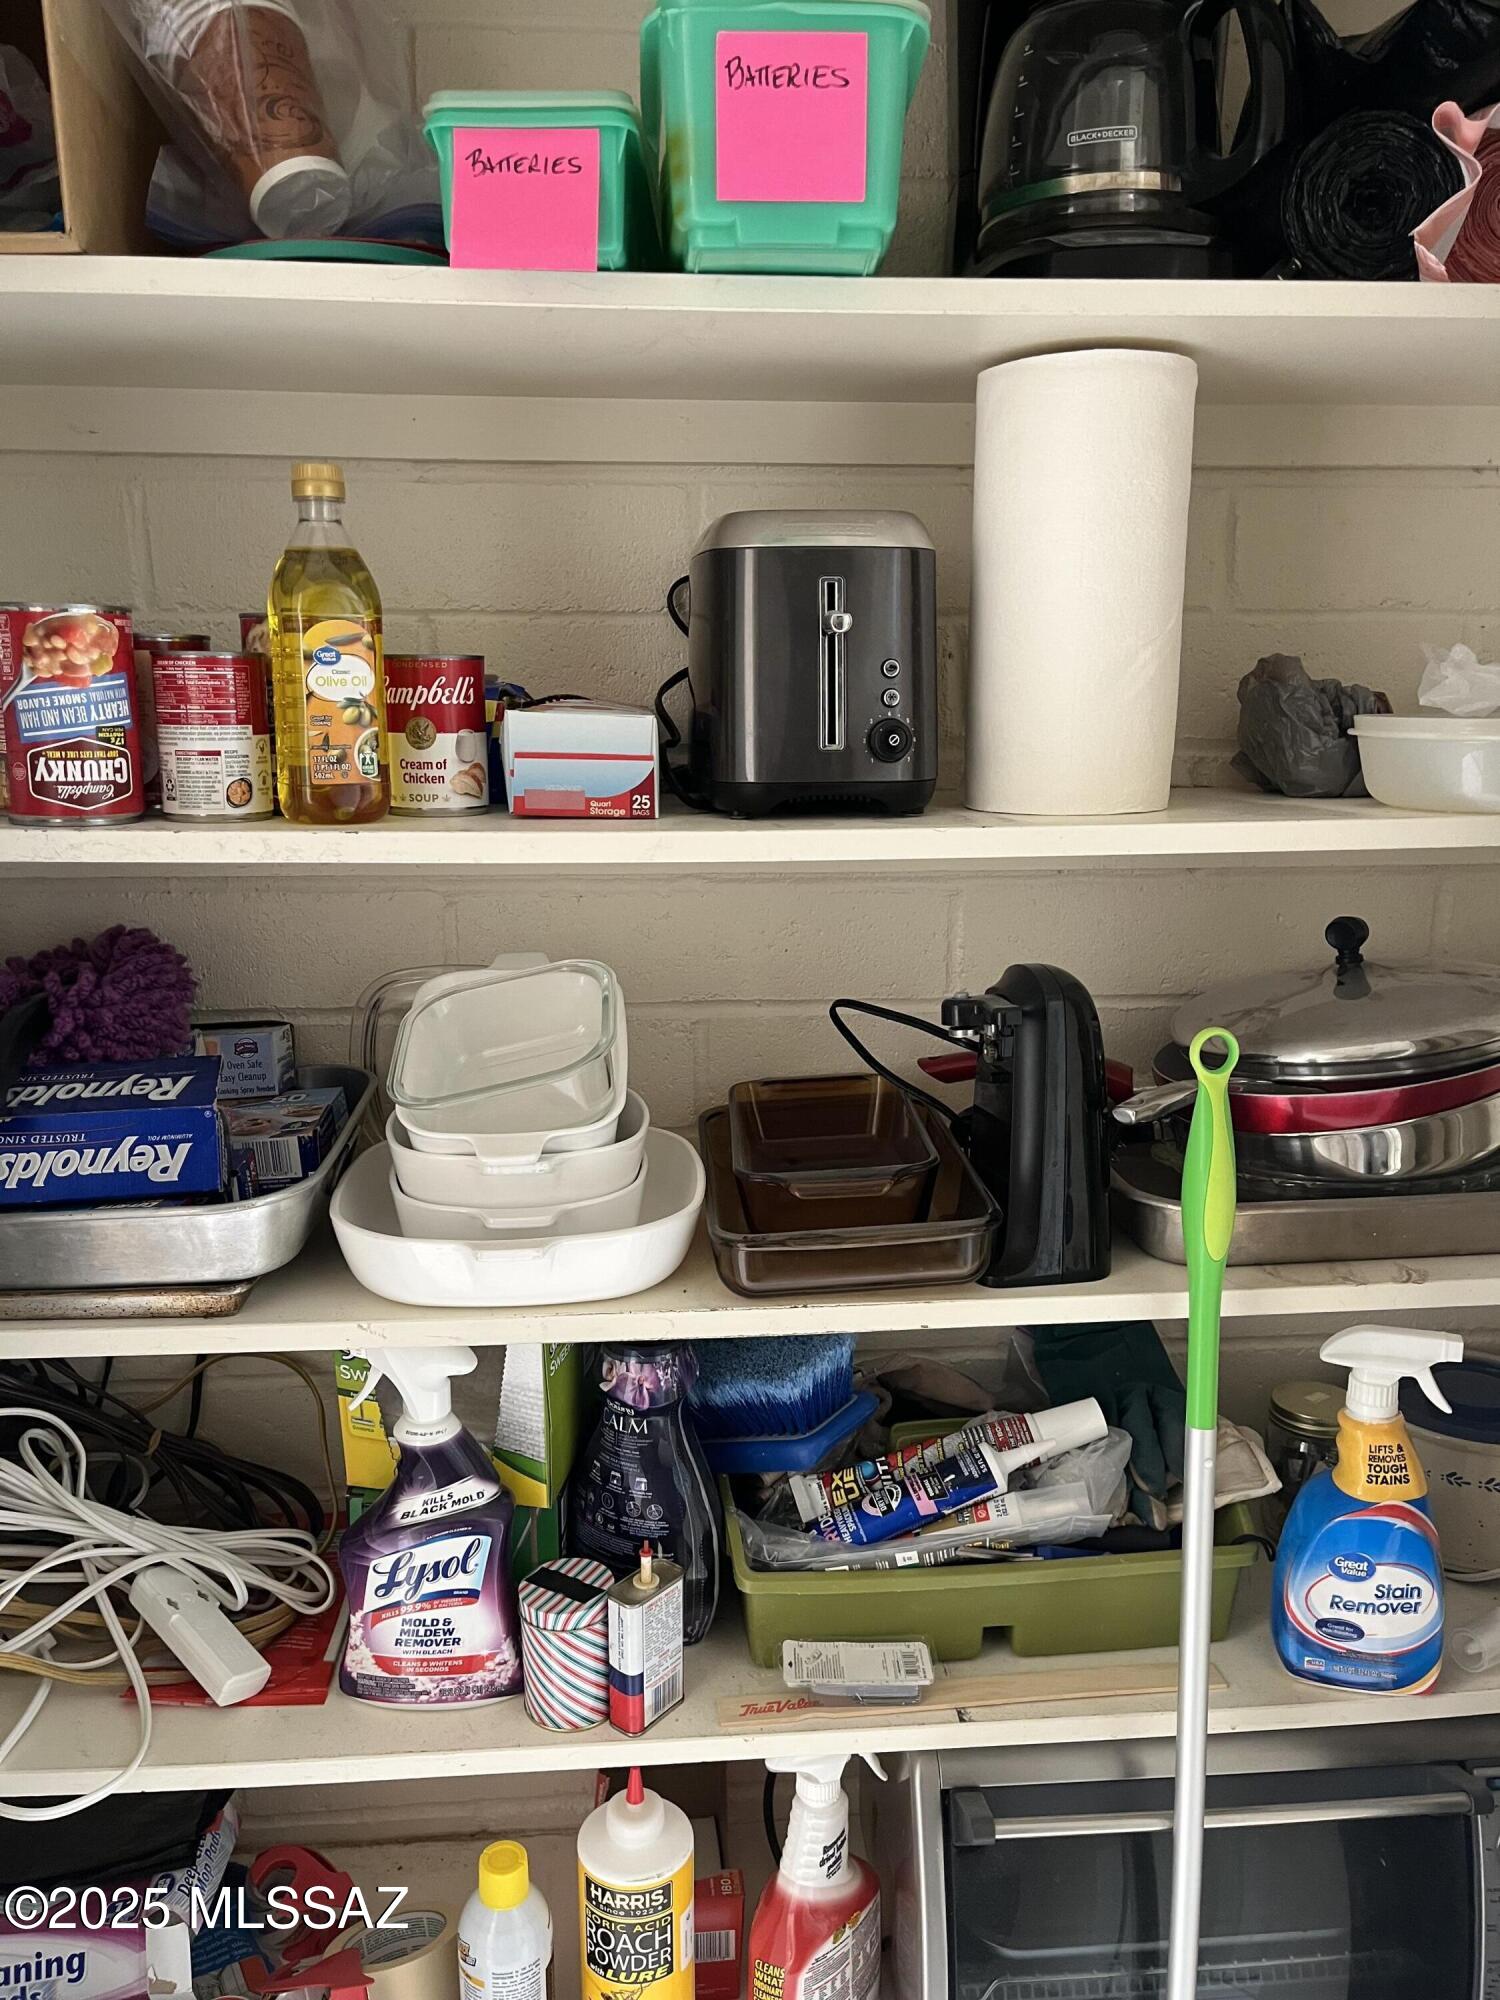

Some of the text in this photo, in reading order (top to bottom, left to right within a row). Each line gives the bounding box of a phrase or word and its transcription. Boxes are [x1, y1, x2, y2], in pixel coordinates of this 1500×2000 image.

[724, 55, 851, 90] BATTERIES
[464, 148, 583, 178] BATTERIES
[315, 675, 368, 687] Olive Oil
[17, 696, 51, 710] FLAVOR
[54, 692, 87, 706] SMOKE
[20, 699, 130, 729] HEARTY BEAN AND HAM
[34, 757, 128, 783] CHUNKY
[400, 758, 447, 771] Cream of
[402, 772, 445, 785] Chicken
[408, 793, 439, 803] SOUP
[589, 800, 612, 808] Quart
[632, 795, 651, 809] 25
[589, 806, 626, 817] Storage
[226, 1059, 263, 1070] Oven Safe
[42, 1072, 97, 1081] TRUSTED
[219, 1072, 267, 1084] Easy Cleanup
[6, 1072, 197, 1108] Reynolds
[240, 1086, 255, 1095] Spray
[256, 1084, 276, 1092] Needed
[31, 1133, 87, 1144] TRUSTED
[0, 1135, 194, 1189] Reynolds
[603, 1406, 648, 1435] CALM
[1368, 1444, 1394, 1455] LIFTS
[1368, 1453, 1406, 1464] REMOVES
[1368, 1463, 1408, 1474] TOUGH
[1366, 1474, 1411, 1485] STAINS
[400, 1491, 486, 1520] BLACK MOLD
[421, 1491, 454, 1507] KILLS
[372, 1537, 481, 1600] Lysol
[1334, 1556, 1369, 1571] Great
[1340, 1567, 1368, 1577] Value
[1373, 1583, 1422, 1600] Stain
[381, 1602, 432, 1620] KILLS 99.9%
[1329, 1594, 1422, 1615] Remover
[401, 1618, 453, 1628] MOLD &
[399, 1627, 455, 1638] MILDEW
[394, 1637, 462, 1648] REMOVER
[429, 1659, 463, 1667] WHITENS
[204, 1830, 221, 1861] Pads
[630, 1908, 654, 1916] 1922
[586, 1907, 671, 1933] BORIC ACID
[587, 1917, 671, 1954] ROACH
[587, 1938, 672, 1972] POWDER
[590, 1962, 669, 1983] with LURE
[754, 1959, 786, 1979] CLEANS
[754, 1967, 785, 1987] WHAT
[753, 1977, 784, 1997] ORDINARY
